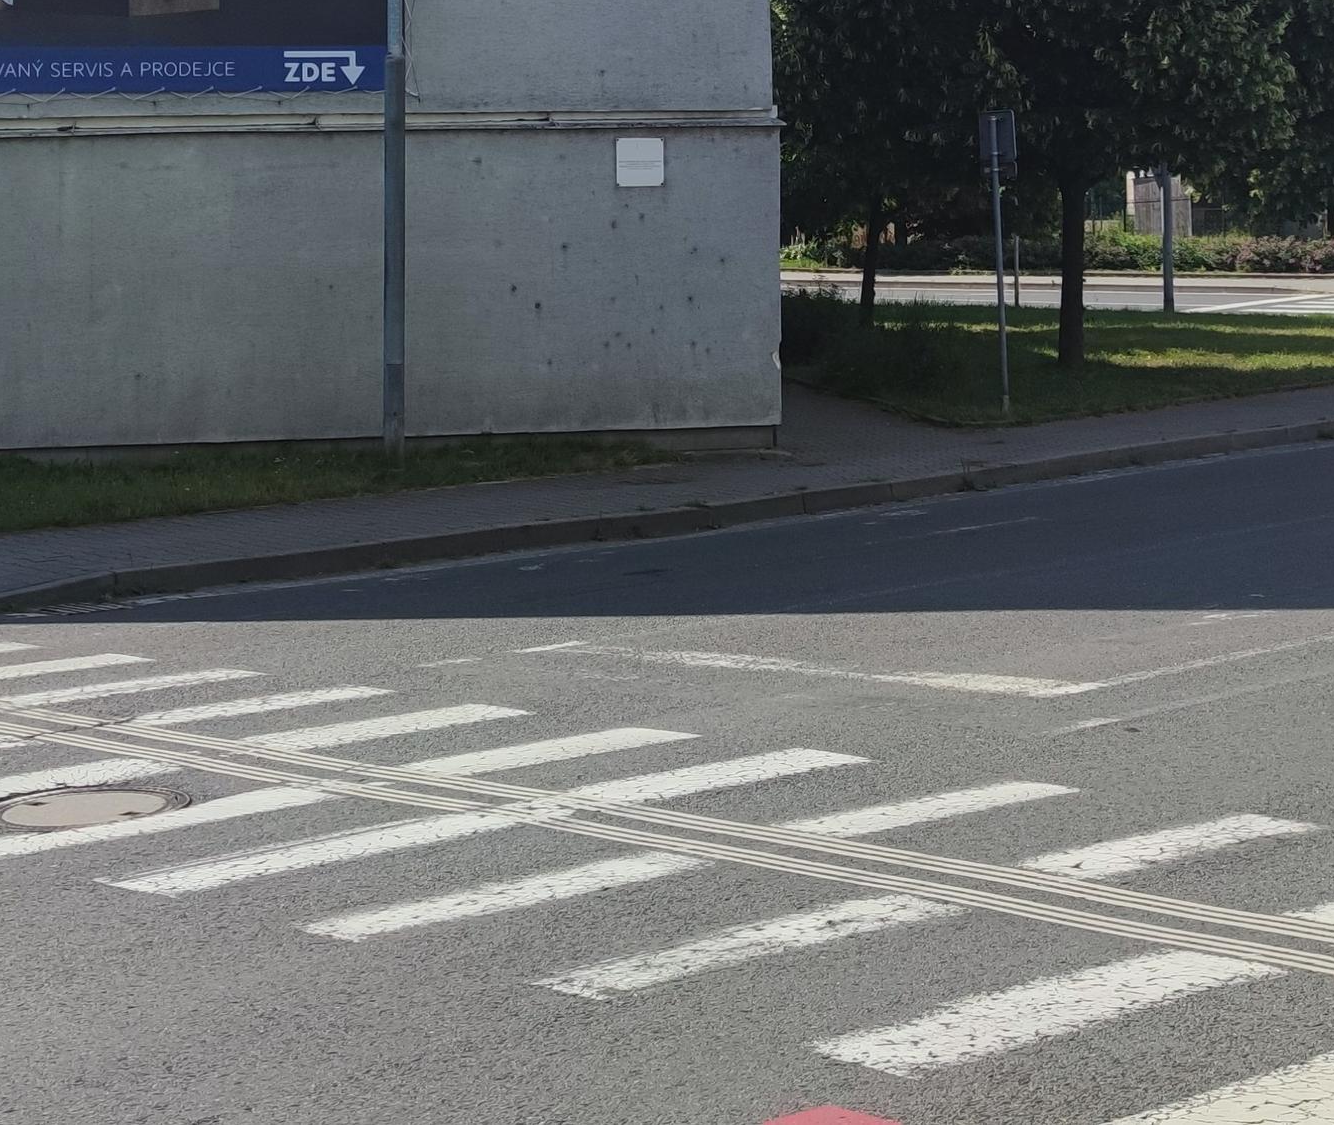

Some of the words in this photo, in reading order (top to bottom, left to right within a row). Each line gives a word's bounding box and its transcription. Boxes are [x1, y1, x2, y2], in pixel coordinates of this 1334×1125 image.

[50, 62, 114, 78] SERVIS
[121, 62, 133, 77] A
[140, 61, 235, 78] PRODEJCE
[284, 62, 336, 83] ZDE
